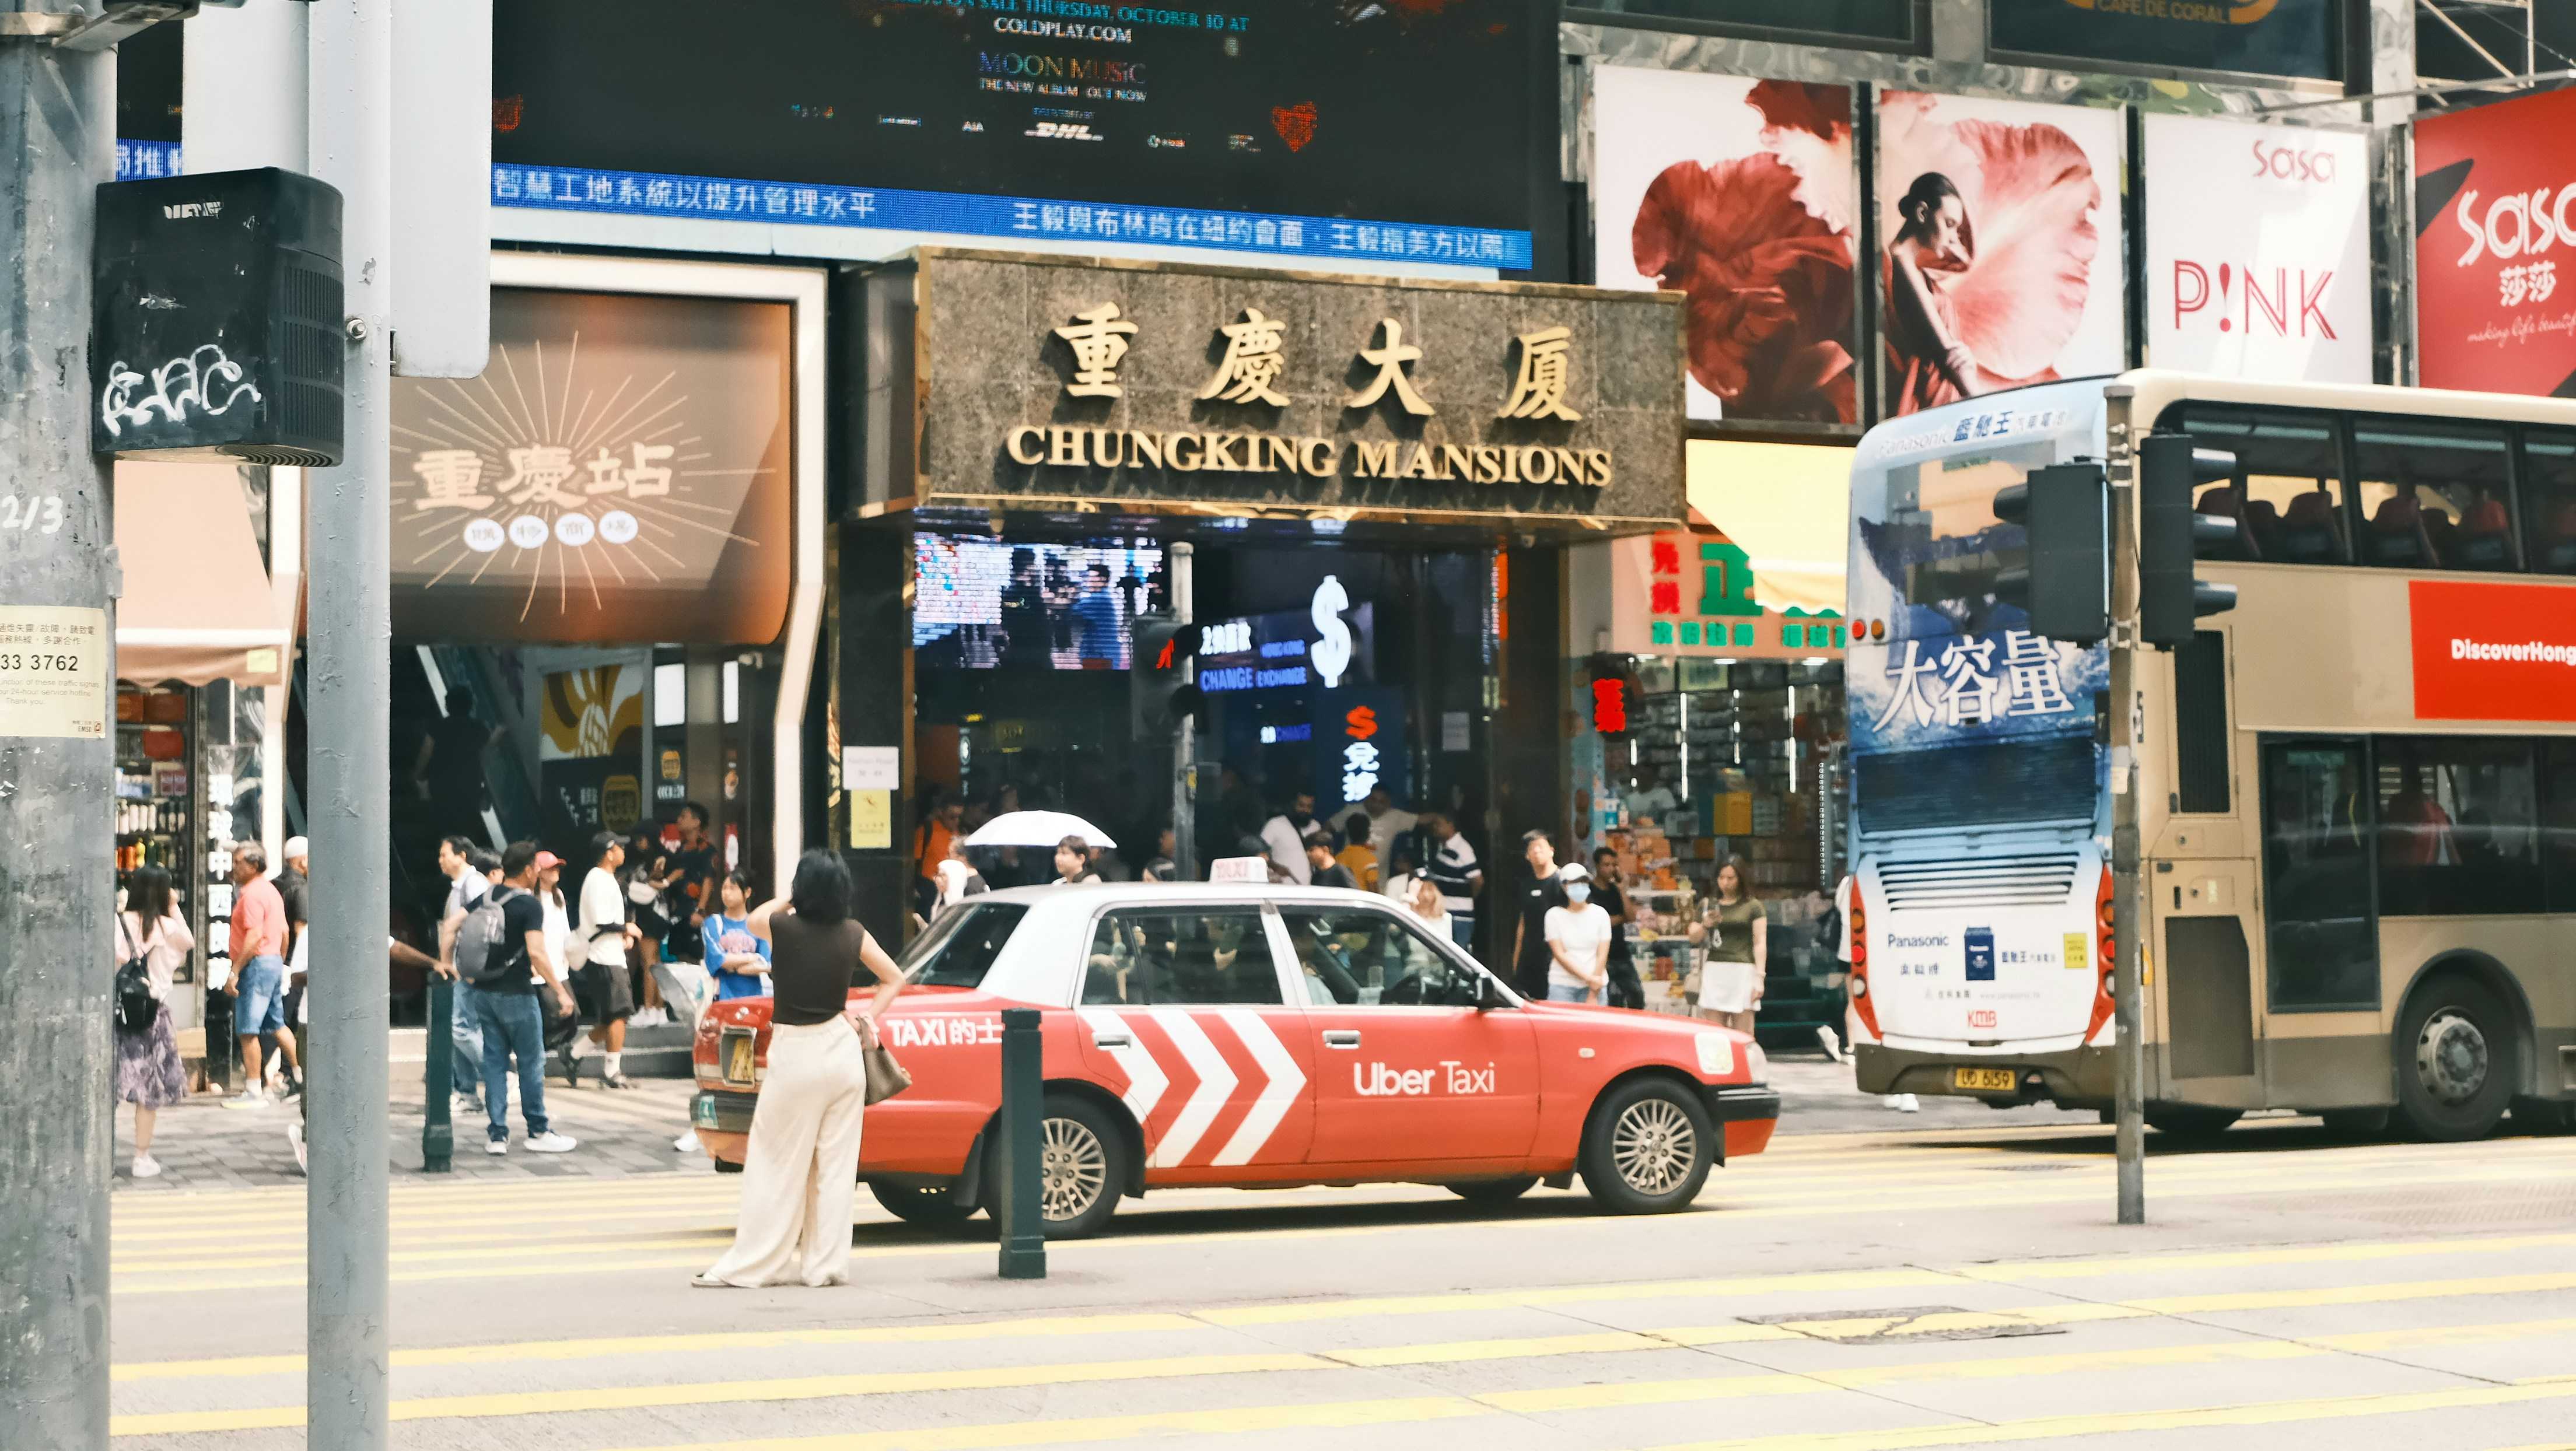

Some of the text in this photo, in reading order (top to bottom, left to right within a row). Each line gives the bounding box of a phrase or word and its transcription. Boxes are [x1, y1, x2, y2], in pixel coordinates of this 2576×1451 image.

[1117, 6, 1199, 28] OCTOBER
[1206, 13, 1224, 30] 10
[1227, 16, 1251, 32] AT
[2146, 1, 2166, 18] DE
[2171, 3, 2231, 24] CORAL
[993, 17, 1132, 43] COLDPLAY.COM
[979, 51, 1064, 79] MOON
[979, 77, 1147, 103] THE NEW ALBUM OUT NOW
[1034, 121, 1092, 140] DHL
[494, 167, 876, 220] 智慧工地系統以提升管理水平
[2500, 260, 2557, 307] 莎莎
[1006, 425, 1613, 489] CHUNGKING MANSIONS
[413, 441, 675, 511] 重慶站
[1, 495, 64, 534] 2/3
[30, 654, 79, 671] 3762
[58, 679, 78, 687] traffic
[1199, 666, 1308, 692] CHANGE EXCHANGE
[1872, 629, 2075, 734] 大容量
[1887, 933, 1950, 948] Panasonic
[886, 1017, 1003, 1047] TAXI 的士
[1353, 1060, 1495, 1096] Uber Taxi
